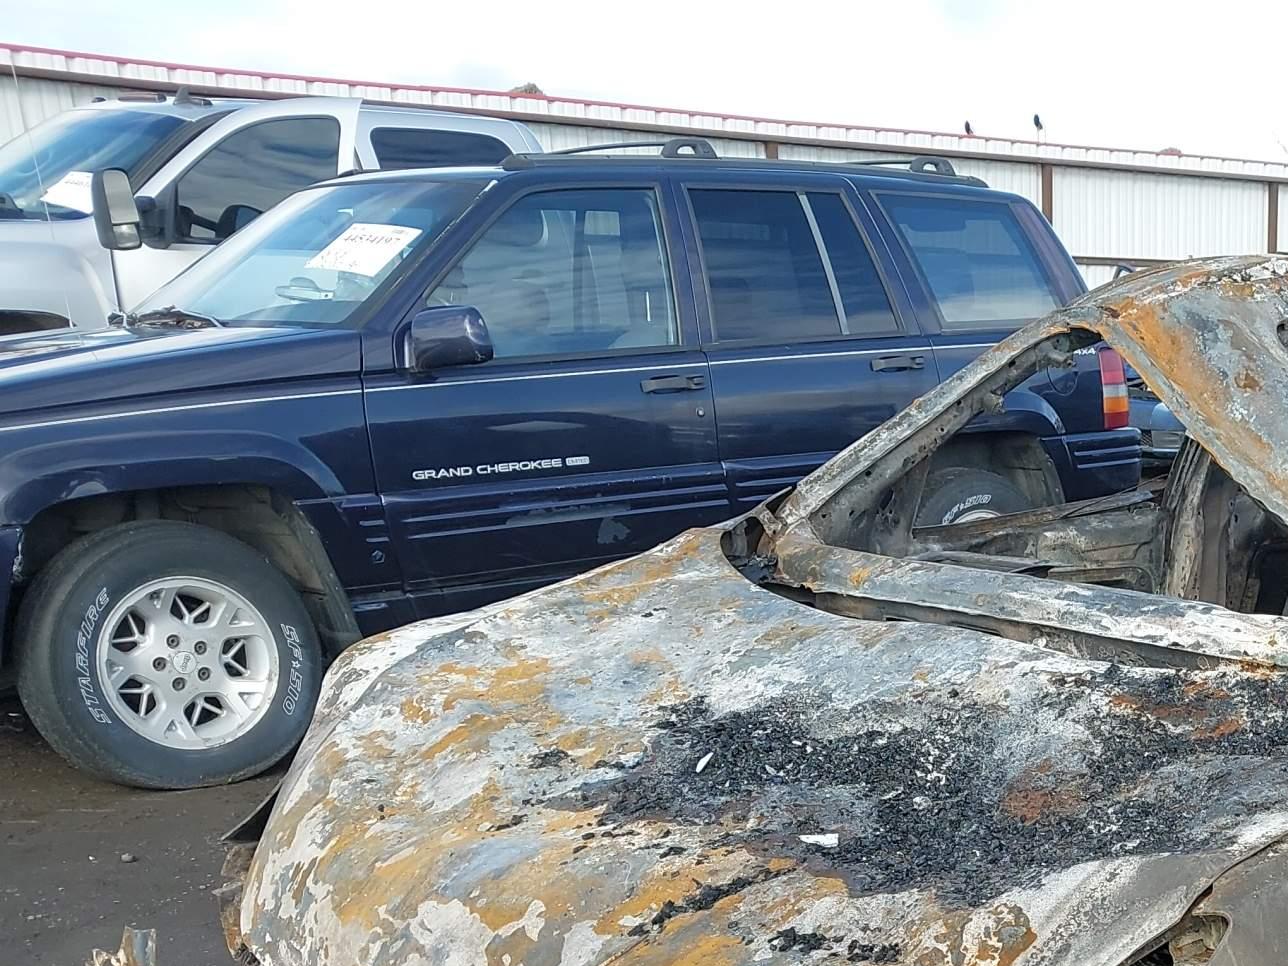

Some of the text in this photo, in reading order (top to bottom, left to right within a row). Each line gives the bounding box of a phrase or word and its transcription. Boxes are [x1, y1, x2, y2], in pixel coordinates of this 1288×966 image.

[411, 466, 473, 480] GRAND
[476, 458, 563, 475] CHEROKEE
[75, 587, 112, 724] STARFIRE
